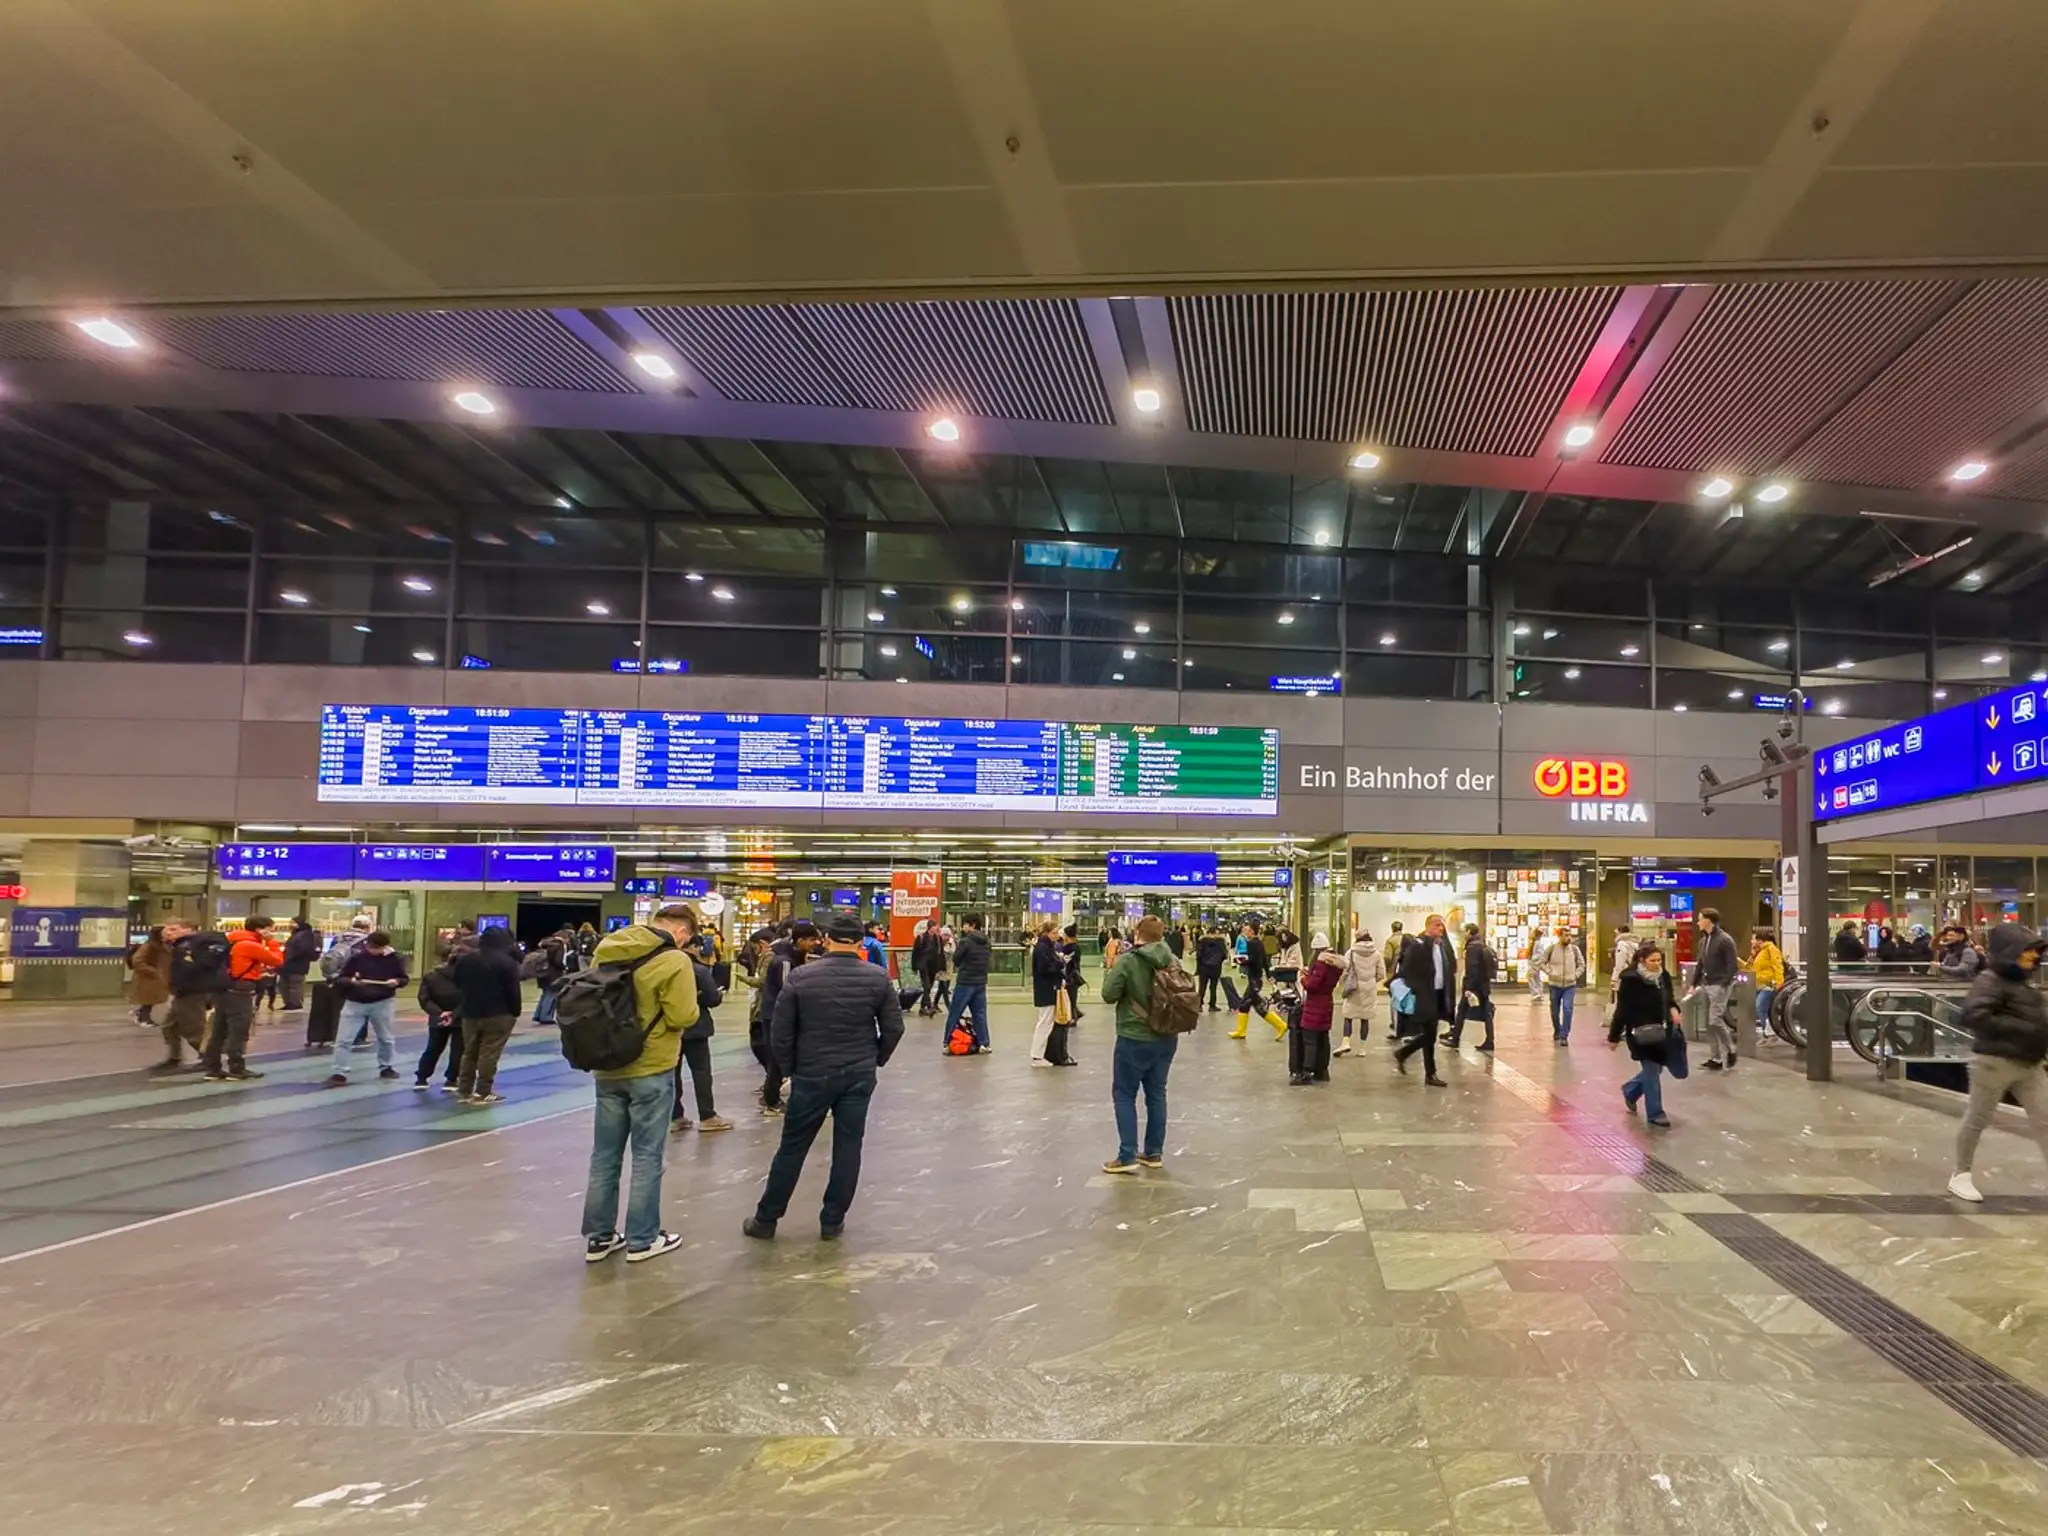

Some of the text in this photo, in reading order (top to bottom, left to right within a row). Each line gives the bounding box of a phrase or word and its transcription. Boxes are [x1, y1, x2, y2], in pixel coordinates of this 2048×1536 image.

[340, 706, 449, 716] Abfahrt Departure
[597, 711, 701, 721] Abfahrt Departure
[842, 718, 941, 728] Abfahrt Departure
[964, 720, 996, 729] 18:52:00
[1074, 724, 1156, 733] Ankunft Arrival
[1883, 743, 1900, 759] WC
[1300, 765, 1495, 791] Ein Bahnhof der
[1533, 758, 1629, 798] ÖBB
[1569, 802, 1648, 823] INFRA
[559, 870, 580, 878] Tickets
[624, 880, 633, 891] 4
[895, 899, 936, 907] INTERSPAR
